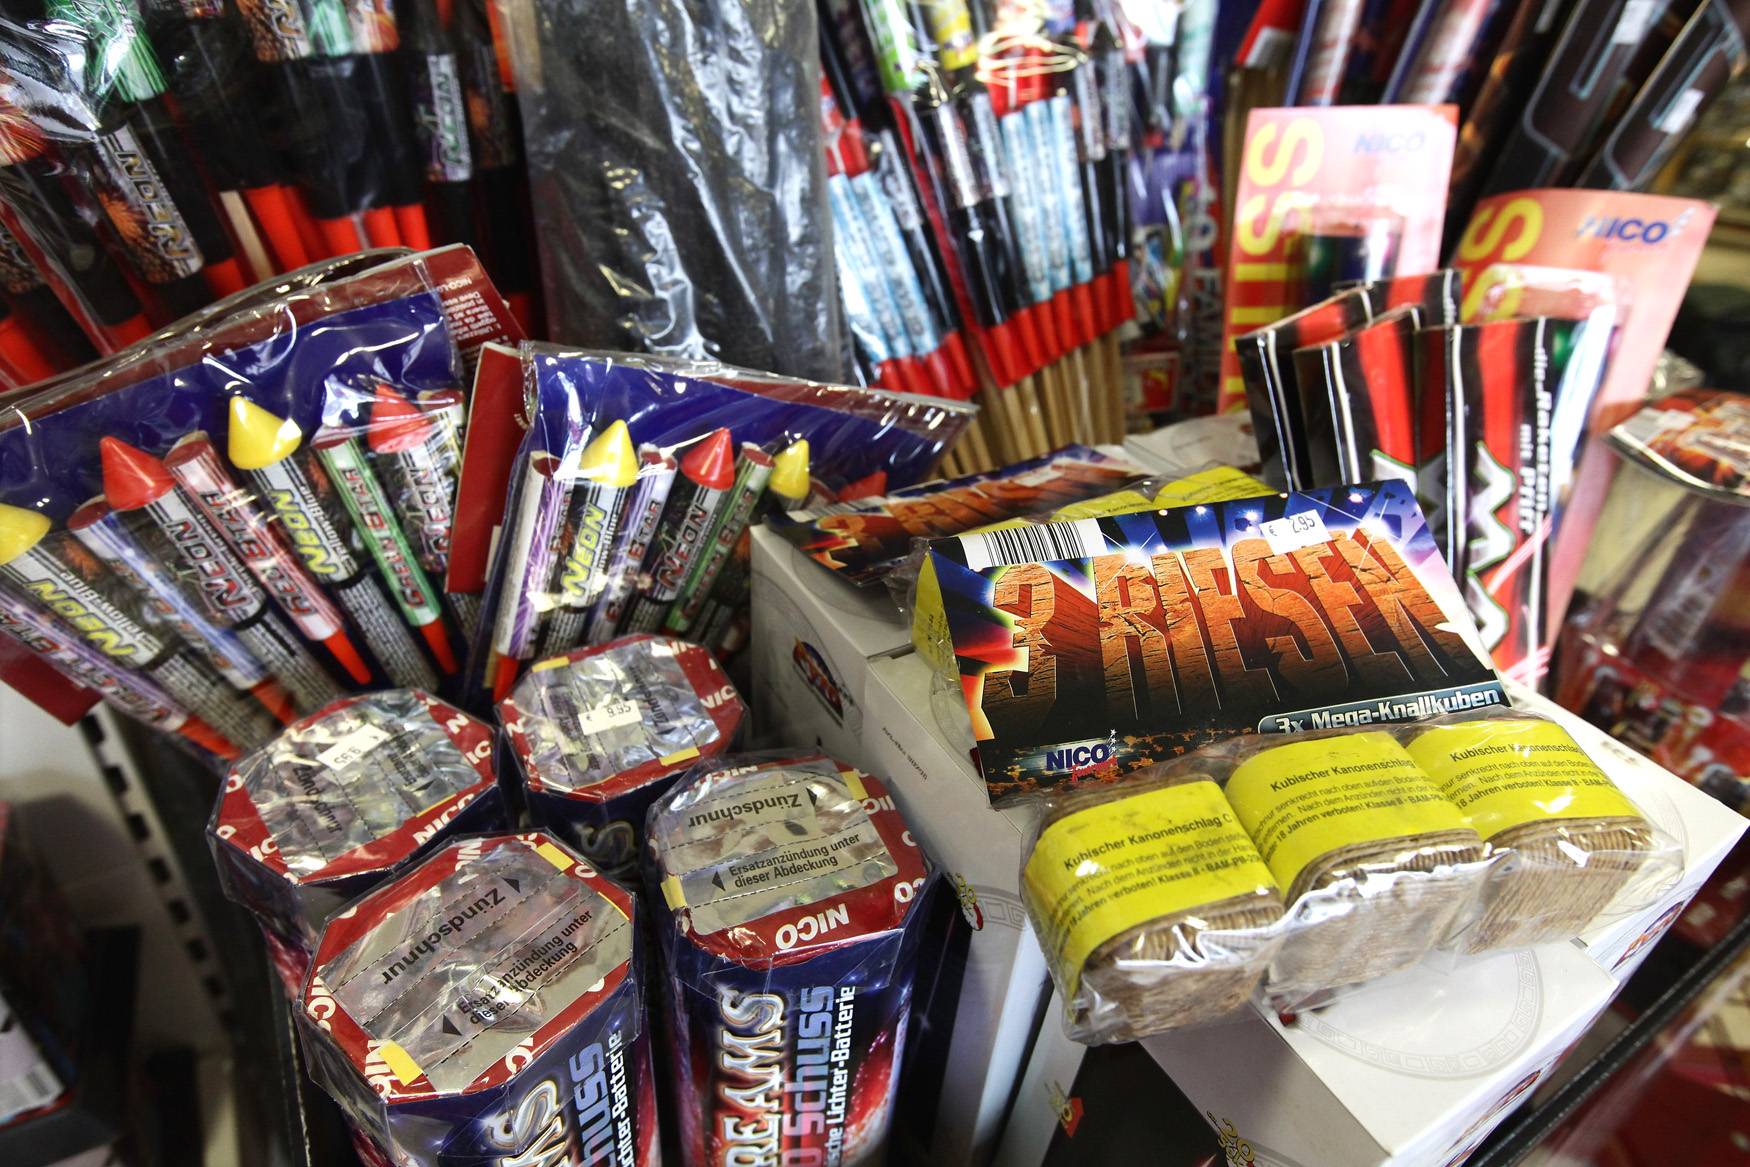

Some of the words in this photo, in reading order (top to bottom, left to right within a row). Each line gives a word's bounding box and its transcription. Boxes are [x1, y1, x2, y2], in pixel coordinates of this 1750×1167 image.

[112, 148, 194, 263] NEON
[1518, 422, 1534, 462] mit
[1535, 389, 1553, 513] Raketen
[267, 488, 339, 575] NEON
[657, 503, 709, 593] NEON
[1289, 512, 1317, 534] 2.95
[166, 518, 251, 609] NEON
[561, 503, 608, 598] NEON
[26, 577, 140, 657] NEON
[59, 571, 149, 638] Yellow-Blue
[1093, 528, 1497, 722] RIESEN
[1274, 717, 1306, 735] 3x
[1311, 687, 1501, 730] Mega-Knallkuben
[1046, 743, 1109, 771] NICO
[1450, 745, 1508, 762] Kubischer
[1270, 770, 1330, 793] Kubischer
[1468, 786, 1502, 804] Jahren
[688, 792, 804, 829] Zündschnur
[1276, 830, 1287, 843] 18
[1287, 814, 1320, 835] Jahren
[1320, 803, 1363, 820] verboten!
[728, 843, 829, 878] Ersatzanzündung
[829, 832, 861, 856] unter
[1063, 838, 1126, 871] Kubischer
[1128, 814, 1223, 846] Kanonenschlag
[733, 872, 771, 890] dieser
[774, 855, 839, 881] Abdeckung
[382, 887, 506, 985] Zündschnur
[560, 909, 593, 938] unter
[775, 903, 850, 951] NICO
[781, 986, 835, 1137] Schuss
[825, 986, 857, 1125] Lichter-Batterie
